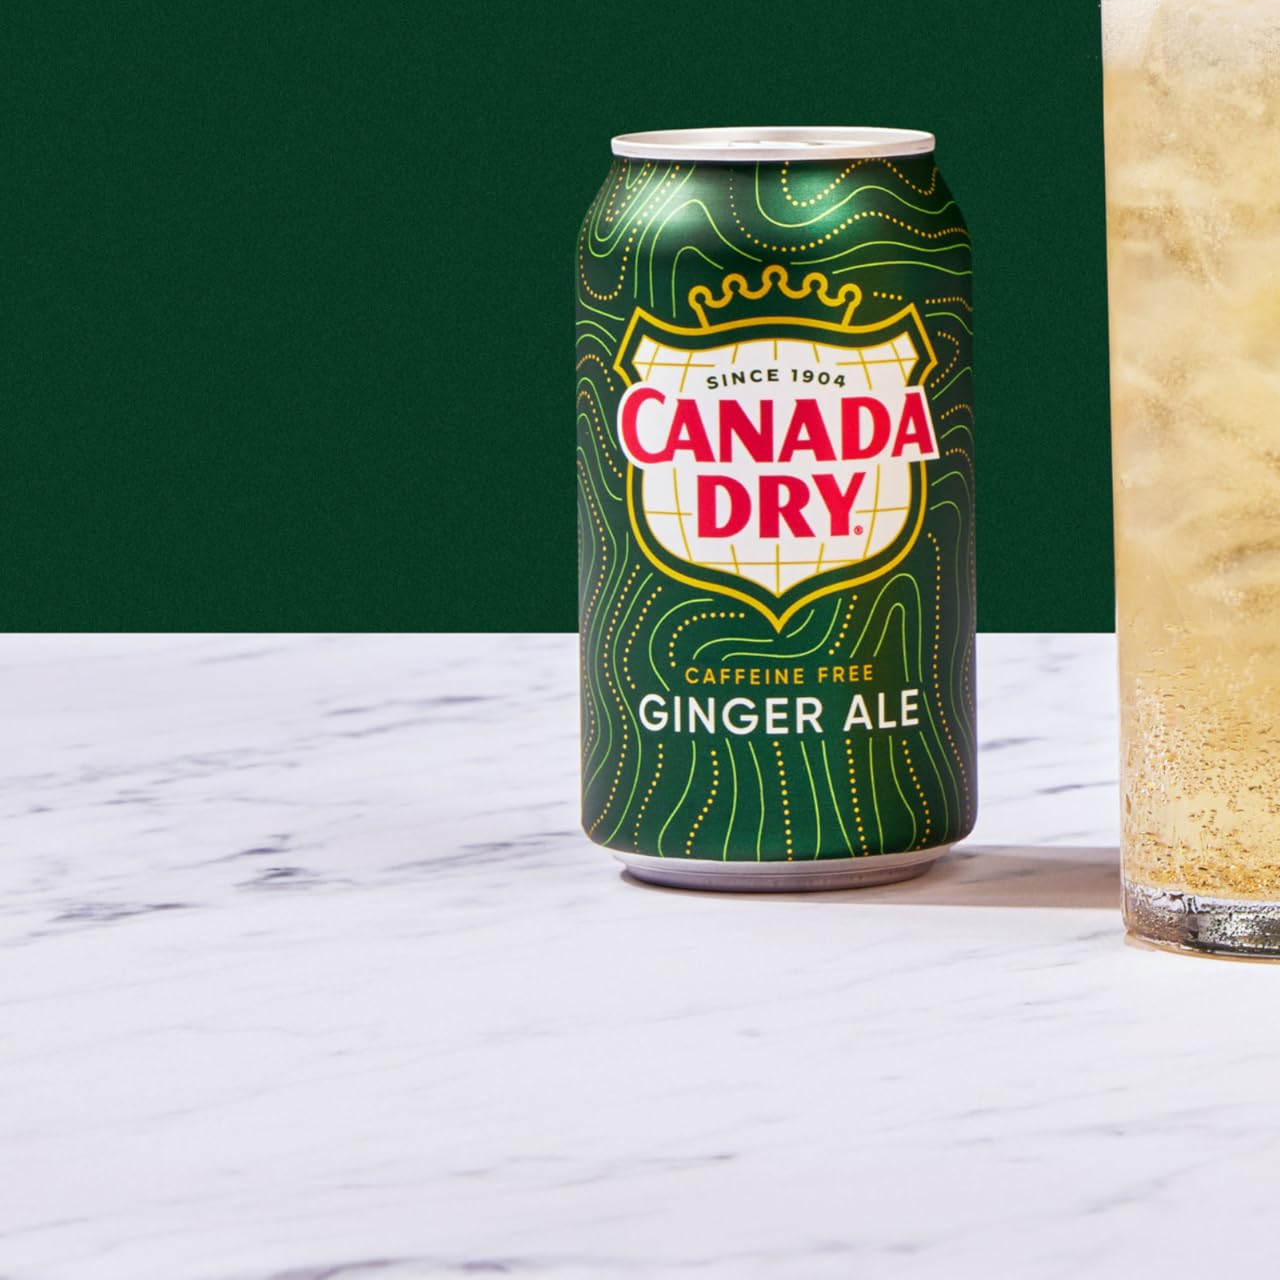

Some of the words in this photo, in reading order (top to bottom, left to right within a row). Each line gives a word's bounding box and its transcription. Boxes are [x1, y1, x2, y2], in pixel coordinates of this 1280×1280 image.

[707, 369, 779, 389] SINCE
[791, 369, 847, 388] 1904
[621, 387, 934, 464] CANADA
[685, 666, 805, 685] CAFFEINE
[817, 665, 874, 682] FREE
[639, 693, 823, 734] GINGER
[843, 689, 920, 732] ALE
